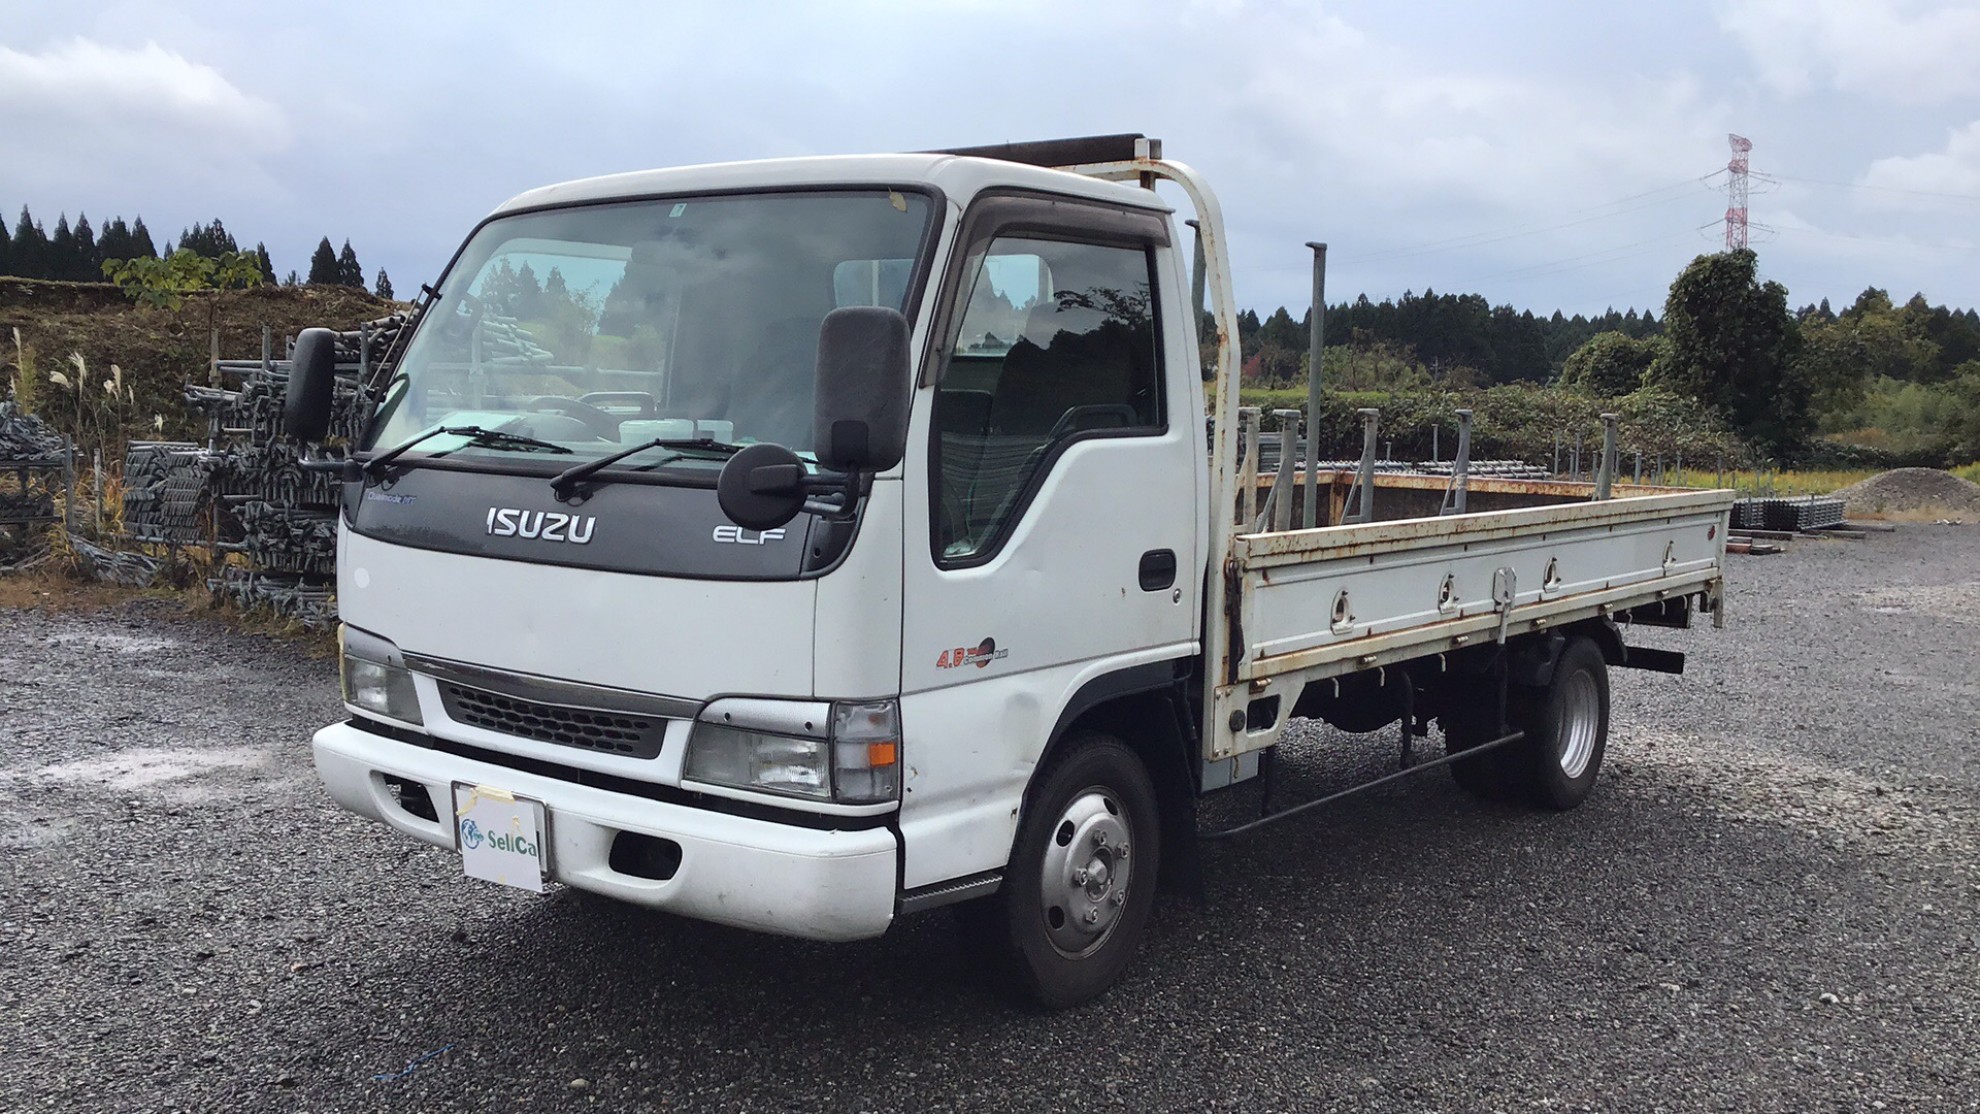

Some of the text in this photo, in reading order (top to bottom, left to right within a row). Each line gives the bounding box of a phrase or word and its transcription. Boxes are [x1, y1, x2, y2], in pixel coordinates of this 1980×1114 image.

[486, 506, 597, 545] ISUZU
[712, 524, 788, 546] ELF
[487, 829, 537, 857] SellCa
